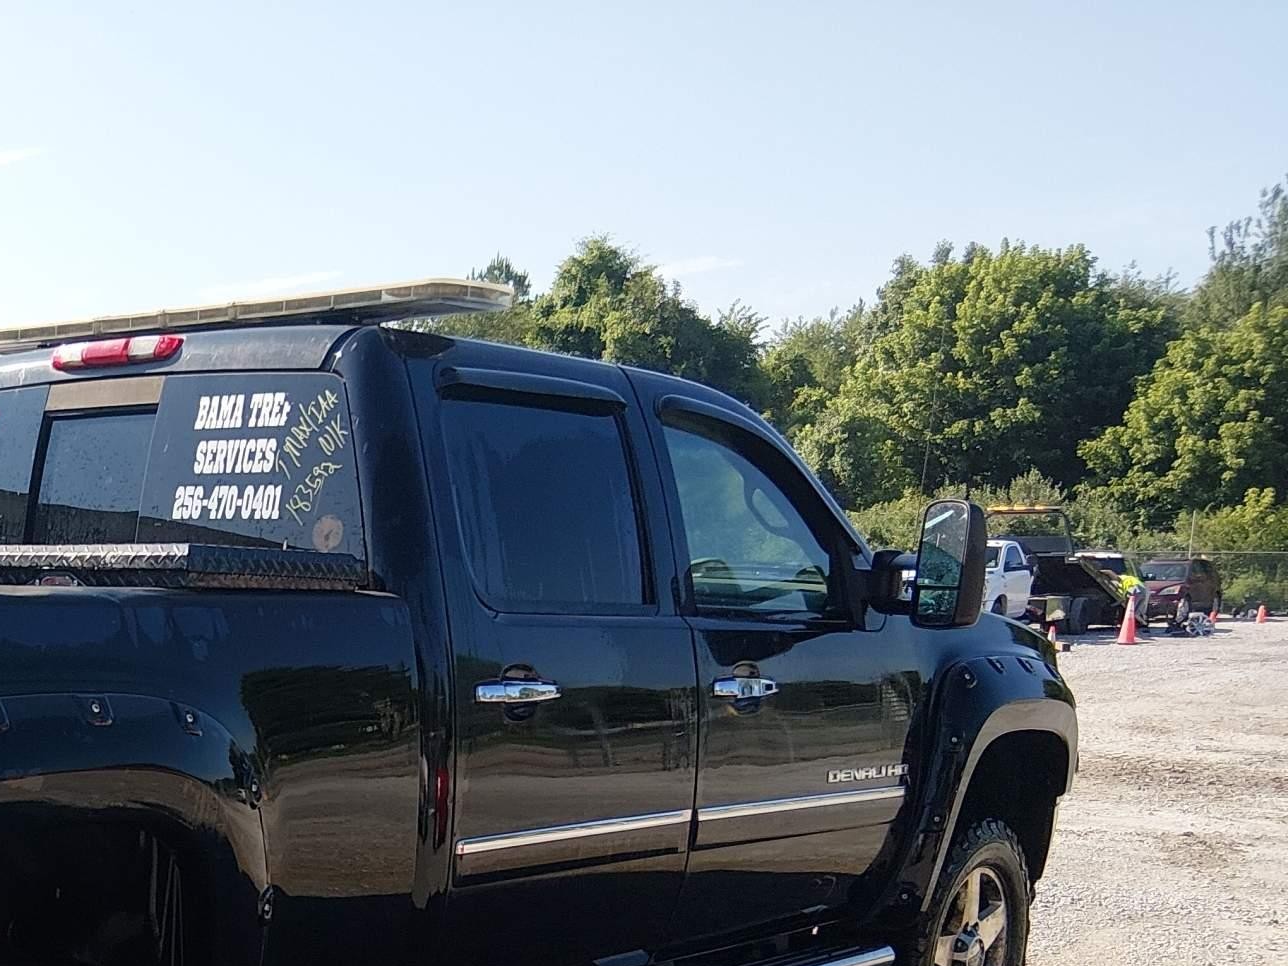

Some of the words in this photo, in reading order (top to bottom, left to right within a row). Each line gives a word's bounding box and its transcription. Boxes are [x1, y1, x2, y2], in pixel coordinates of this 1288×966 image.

[194, 394, 245, 430] BAMA
[194, 438, 277, 474] SERVICES
[172, 485, 282, 520] 256-470-0401
[827, 766, 886, 784] DENALI
